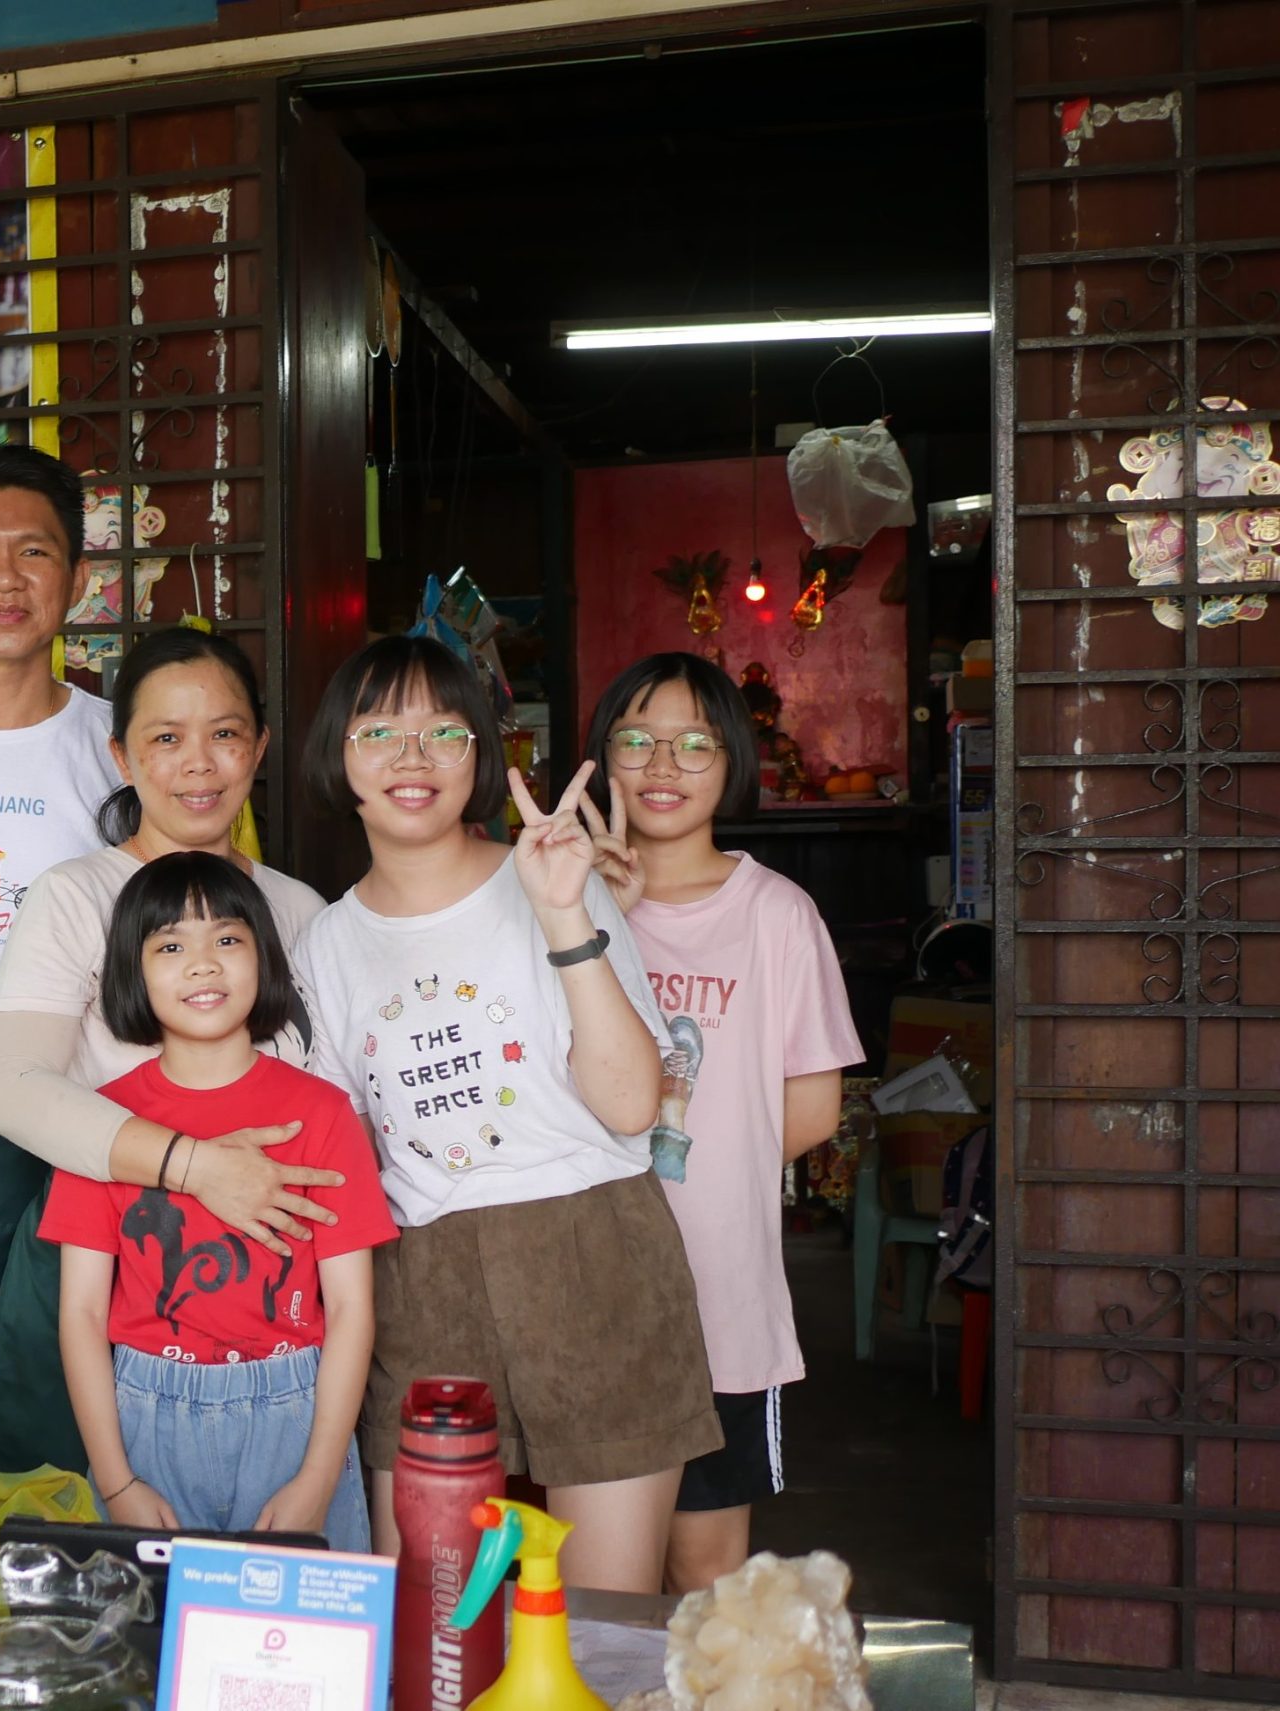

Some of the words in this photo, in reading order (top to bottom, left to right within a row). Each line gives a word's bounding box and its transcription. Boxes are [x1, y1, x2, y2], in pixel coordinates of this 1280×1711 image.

[410, 1023, 462, 1052] THE
[398, 1051, 482, 1087] GREAT
[414, 1086, 483, 1119] RACE
[183, 1567, 202, 1581] We
[204, 1571, 238, 1586] prefer
[300, 1565, 330, 1578] Other
[332, 1569, 379, 1584] eWallets
[310, 1577, 335, 1589] bank
[338, 1581, 365, 1594] apps
[298, 1598, 324, 1610] Scan
[326, 1600, 345, 1612] this
